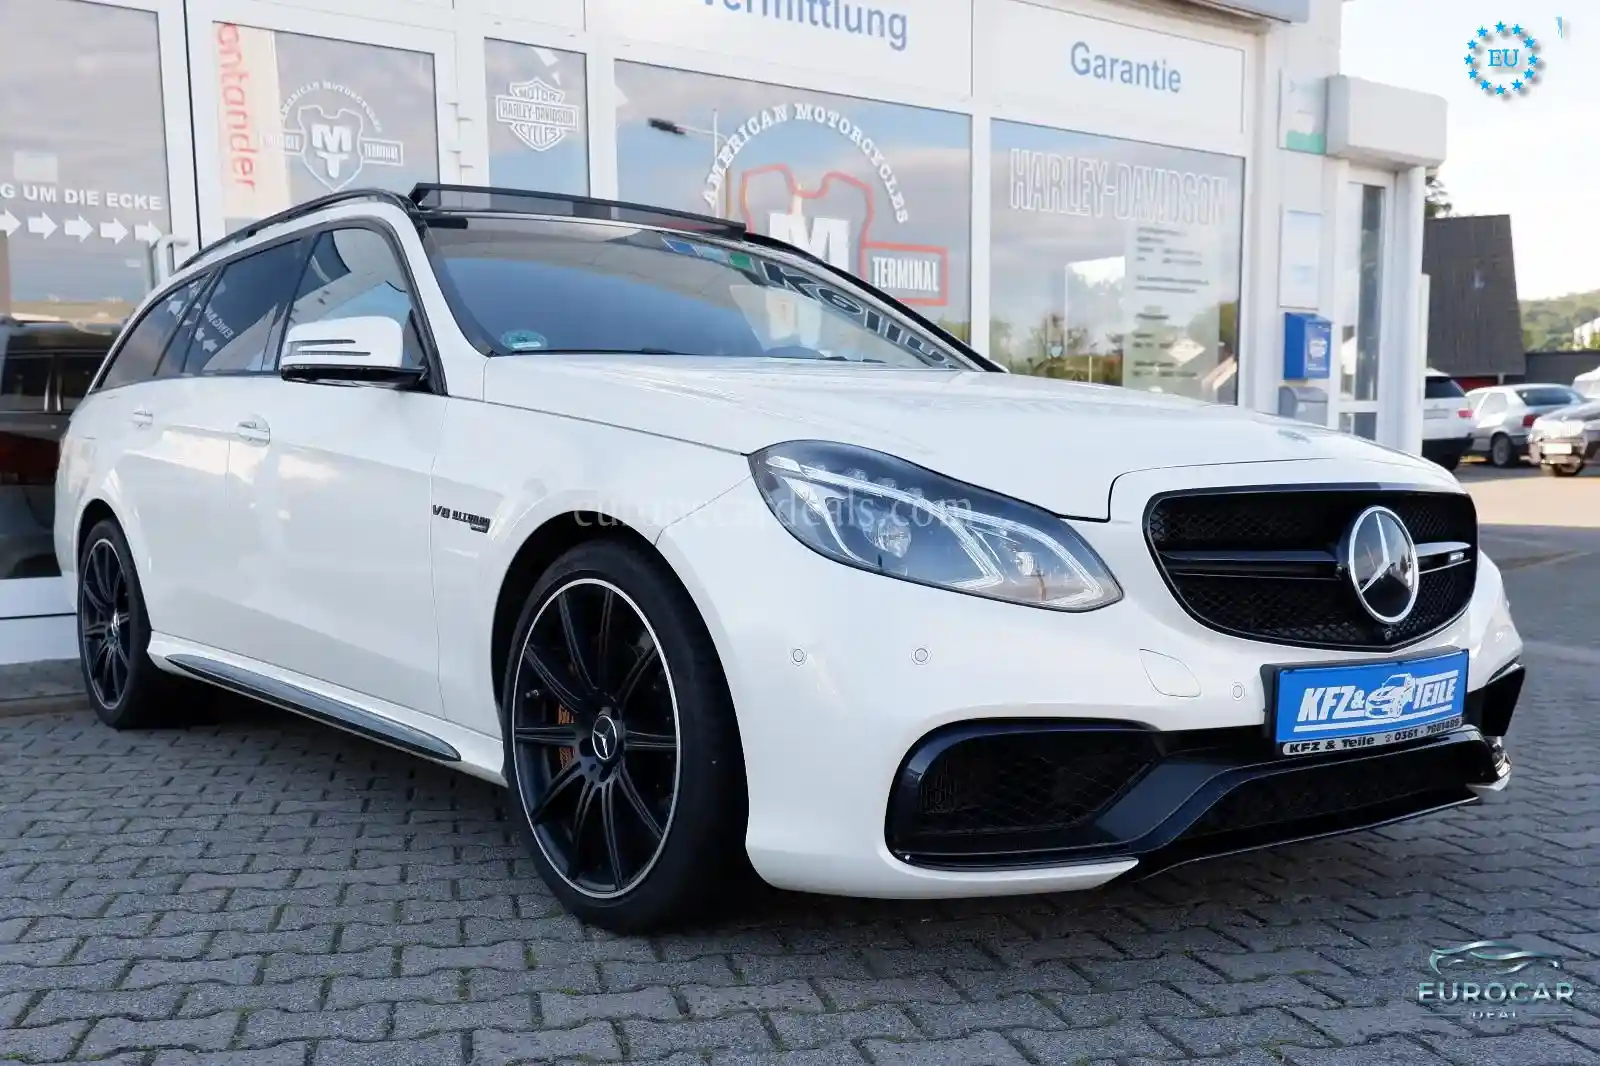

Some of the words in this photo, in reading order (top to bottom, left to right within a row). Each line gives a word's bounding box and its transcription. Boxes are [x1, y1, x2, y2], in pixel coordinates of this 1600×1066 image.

[705, 0, 907, 51] mittlung
[1071, 41, 1181, 93] Garantie
[702, 103, 789, 209] AMERICAN
[794, 103, 909, 223] MOTORCYCLES
[23, 185, 57, 203] UM
[64, 189, 101, 207] DIE
[106, 192, 163, 210] ECKE
[1010, 148, 1228, 225] HARLEY-DAVIDSON
[872, 256, 940, 292] TERMINAL
[432, 504, 451, 519] V8
[1412, 670, 1459, 709] TEILE
[1289, 741, 1321, 754] KFZ
[1325, 740, 1337, 750] &
[1342, 735, 1376, 749] Teile
[1394, 727, 1419, 741] 0361
